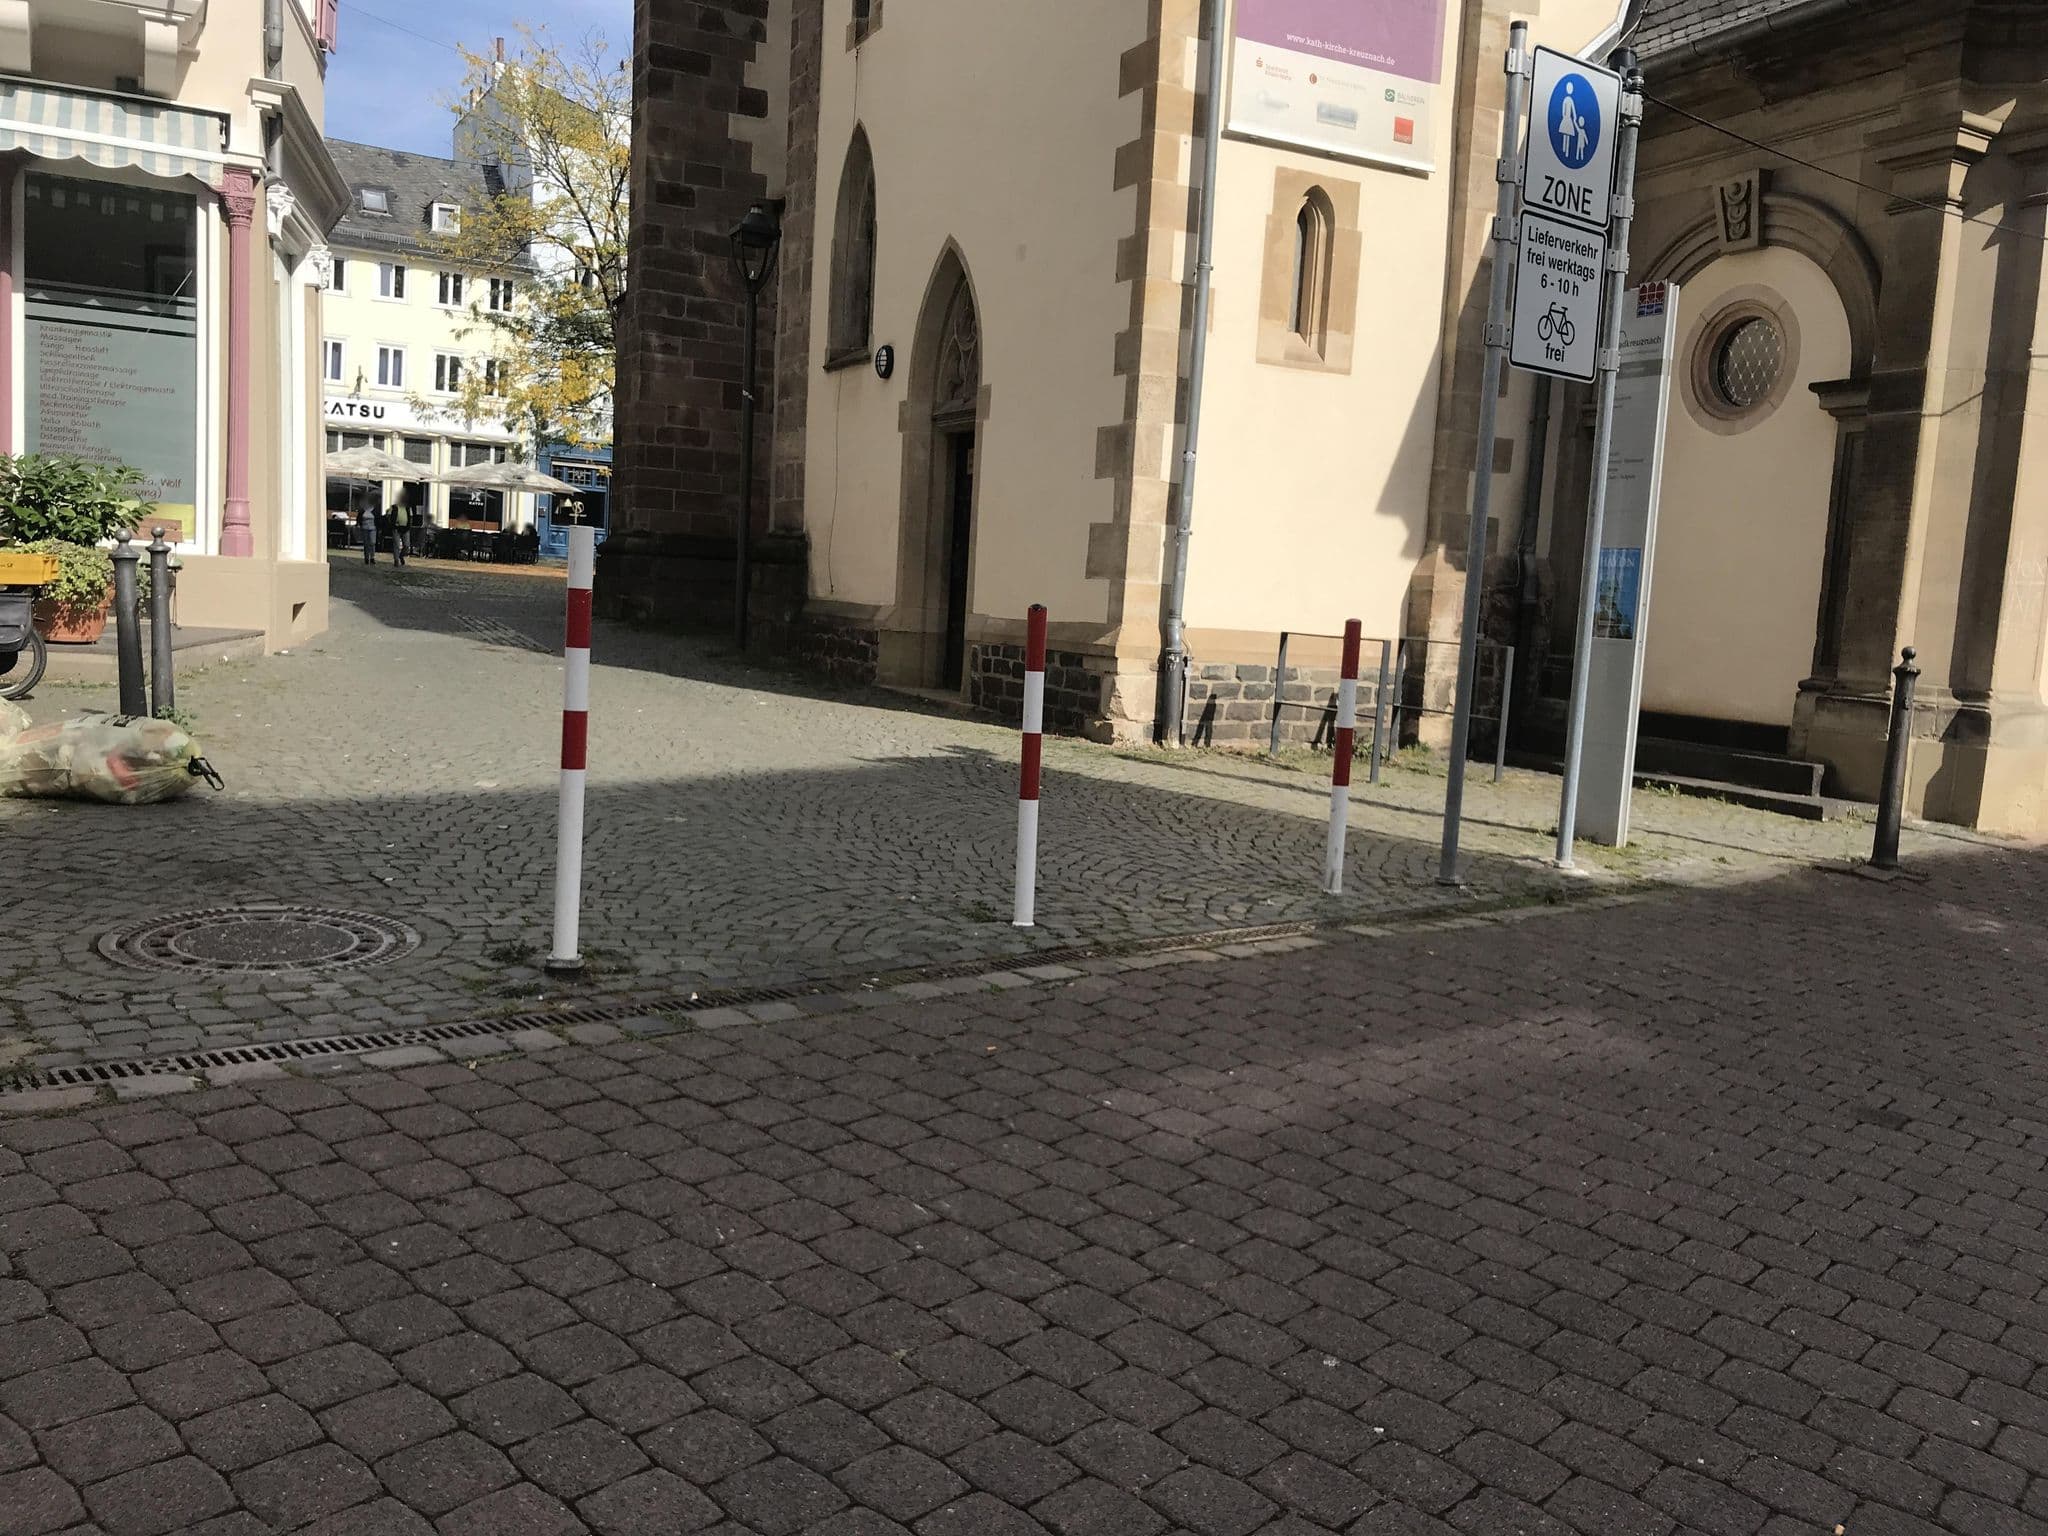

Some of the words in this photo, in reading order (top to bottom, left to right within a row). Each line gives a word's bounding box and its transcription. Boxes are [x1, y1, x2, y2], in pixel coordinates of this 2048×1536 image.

[1286, 33, 1396, 66] www.kath-kirche-kreuznach.de
[1542, 175, 1593, 216] ZONE
[1528, 226, 1598, 260] Lieferverkehr
[1527, 247, 1546, 267] frei
[1548, 256, 1595, 282] werktags
[1541, 274, 1548, 288] 6
[1558, 278, 1570, 295] 10
[1572, 281, 1579, 297] h
[40, 334, 82, 344] Massagen
[40, 341, 65, 352] Fango
[1545, 342, 1565, 362] frei
[161, 478, 182, 488] Wolf
